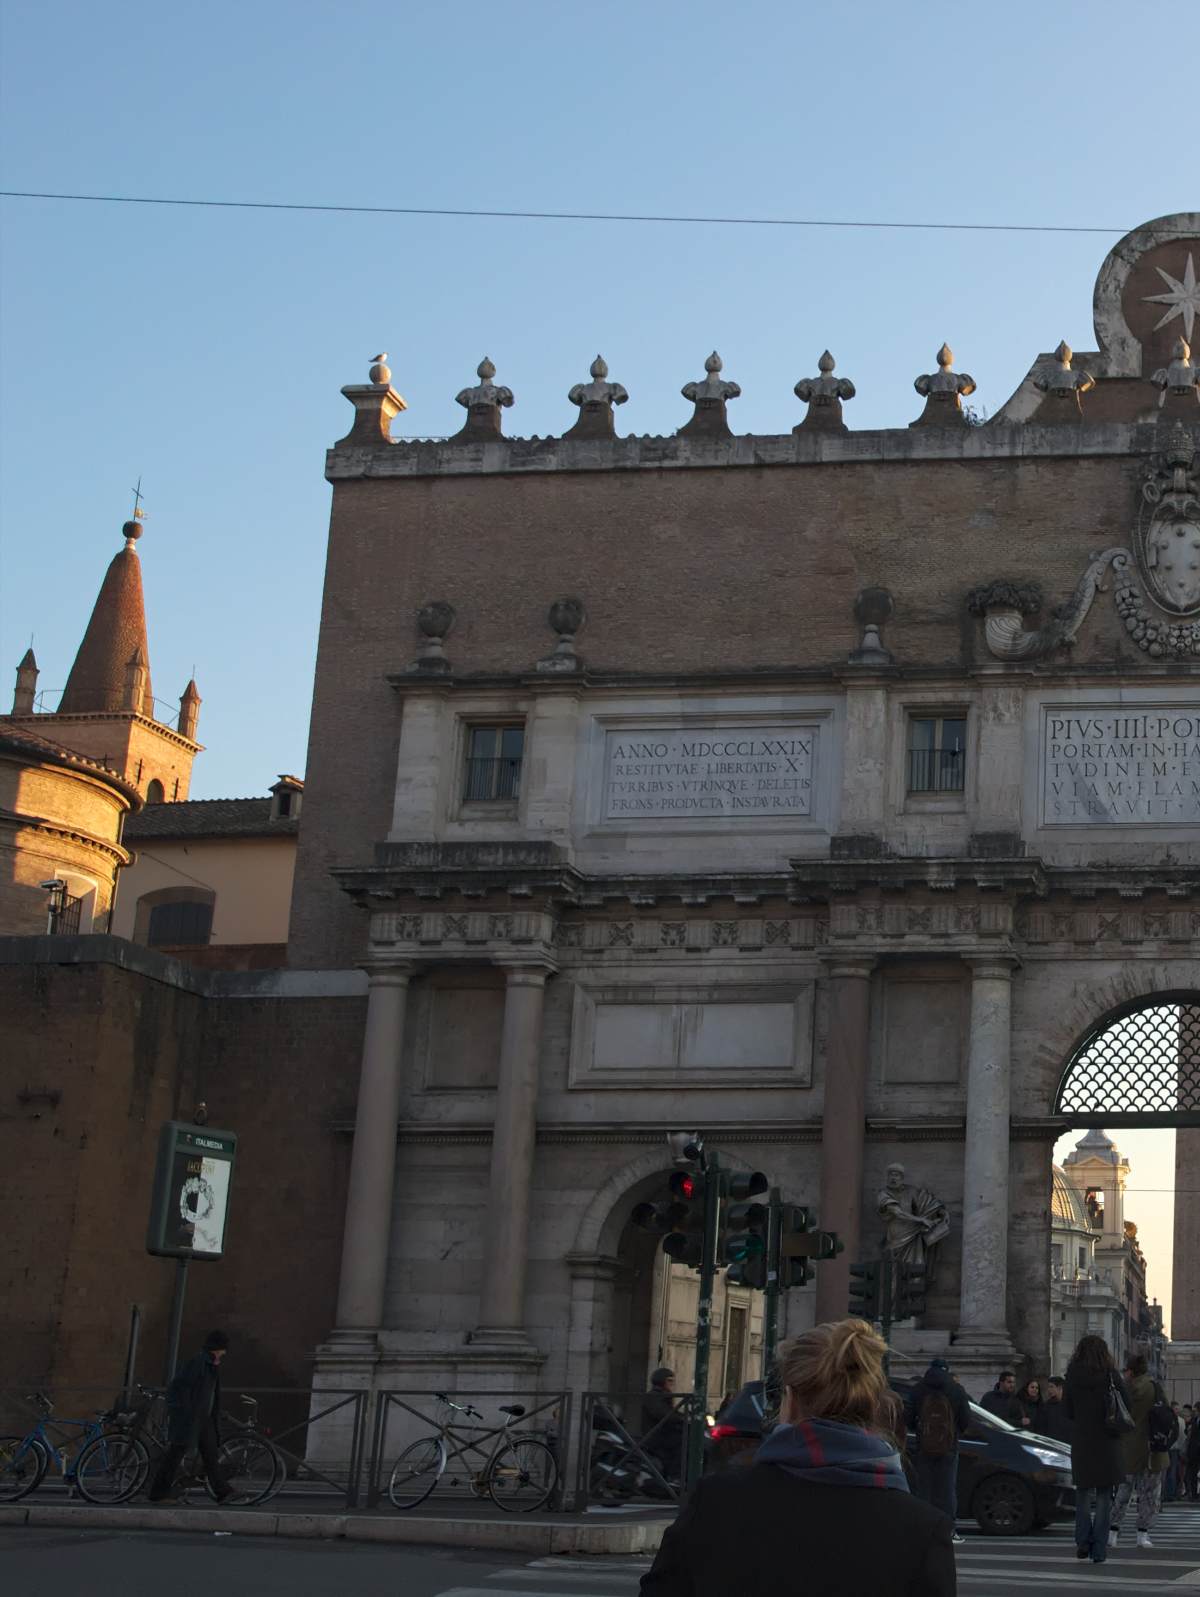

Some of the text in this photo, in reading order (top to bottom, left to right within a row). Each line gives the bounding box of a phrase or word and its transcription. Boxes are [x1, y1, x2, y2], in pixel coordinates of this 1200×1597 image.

[1050, 718, 1104, 740] PIVS
[1114, 715, 1148, 739] IIII
[612, 740, 812, 760] ANNO MDCCCLXXIX
[1051, 743, 1135, 759] PORTAM
[1143, 743, 1165, 758] IN
[615, 758, 800, 776] RESTITVTAE LIBERTATIS X
[1052, 762, 1168, 778] TVDINEM
[609, 778, 811, 794] TVRRIBVS VTRINQVE DELETIS
[1051, 781, 1122, 796] VIAM
[612, 796, 805, 811] FRONS PRODVCTA INSTAVRATA
[1053, 800, 1172, 816] STRAVIT
